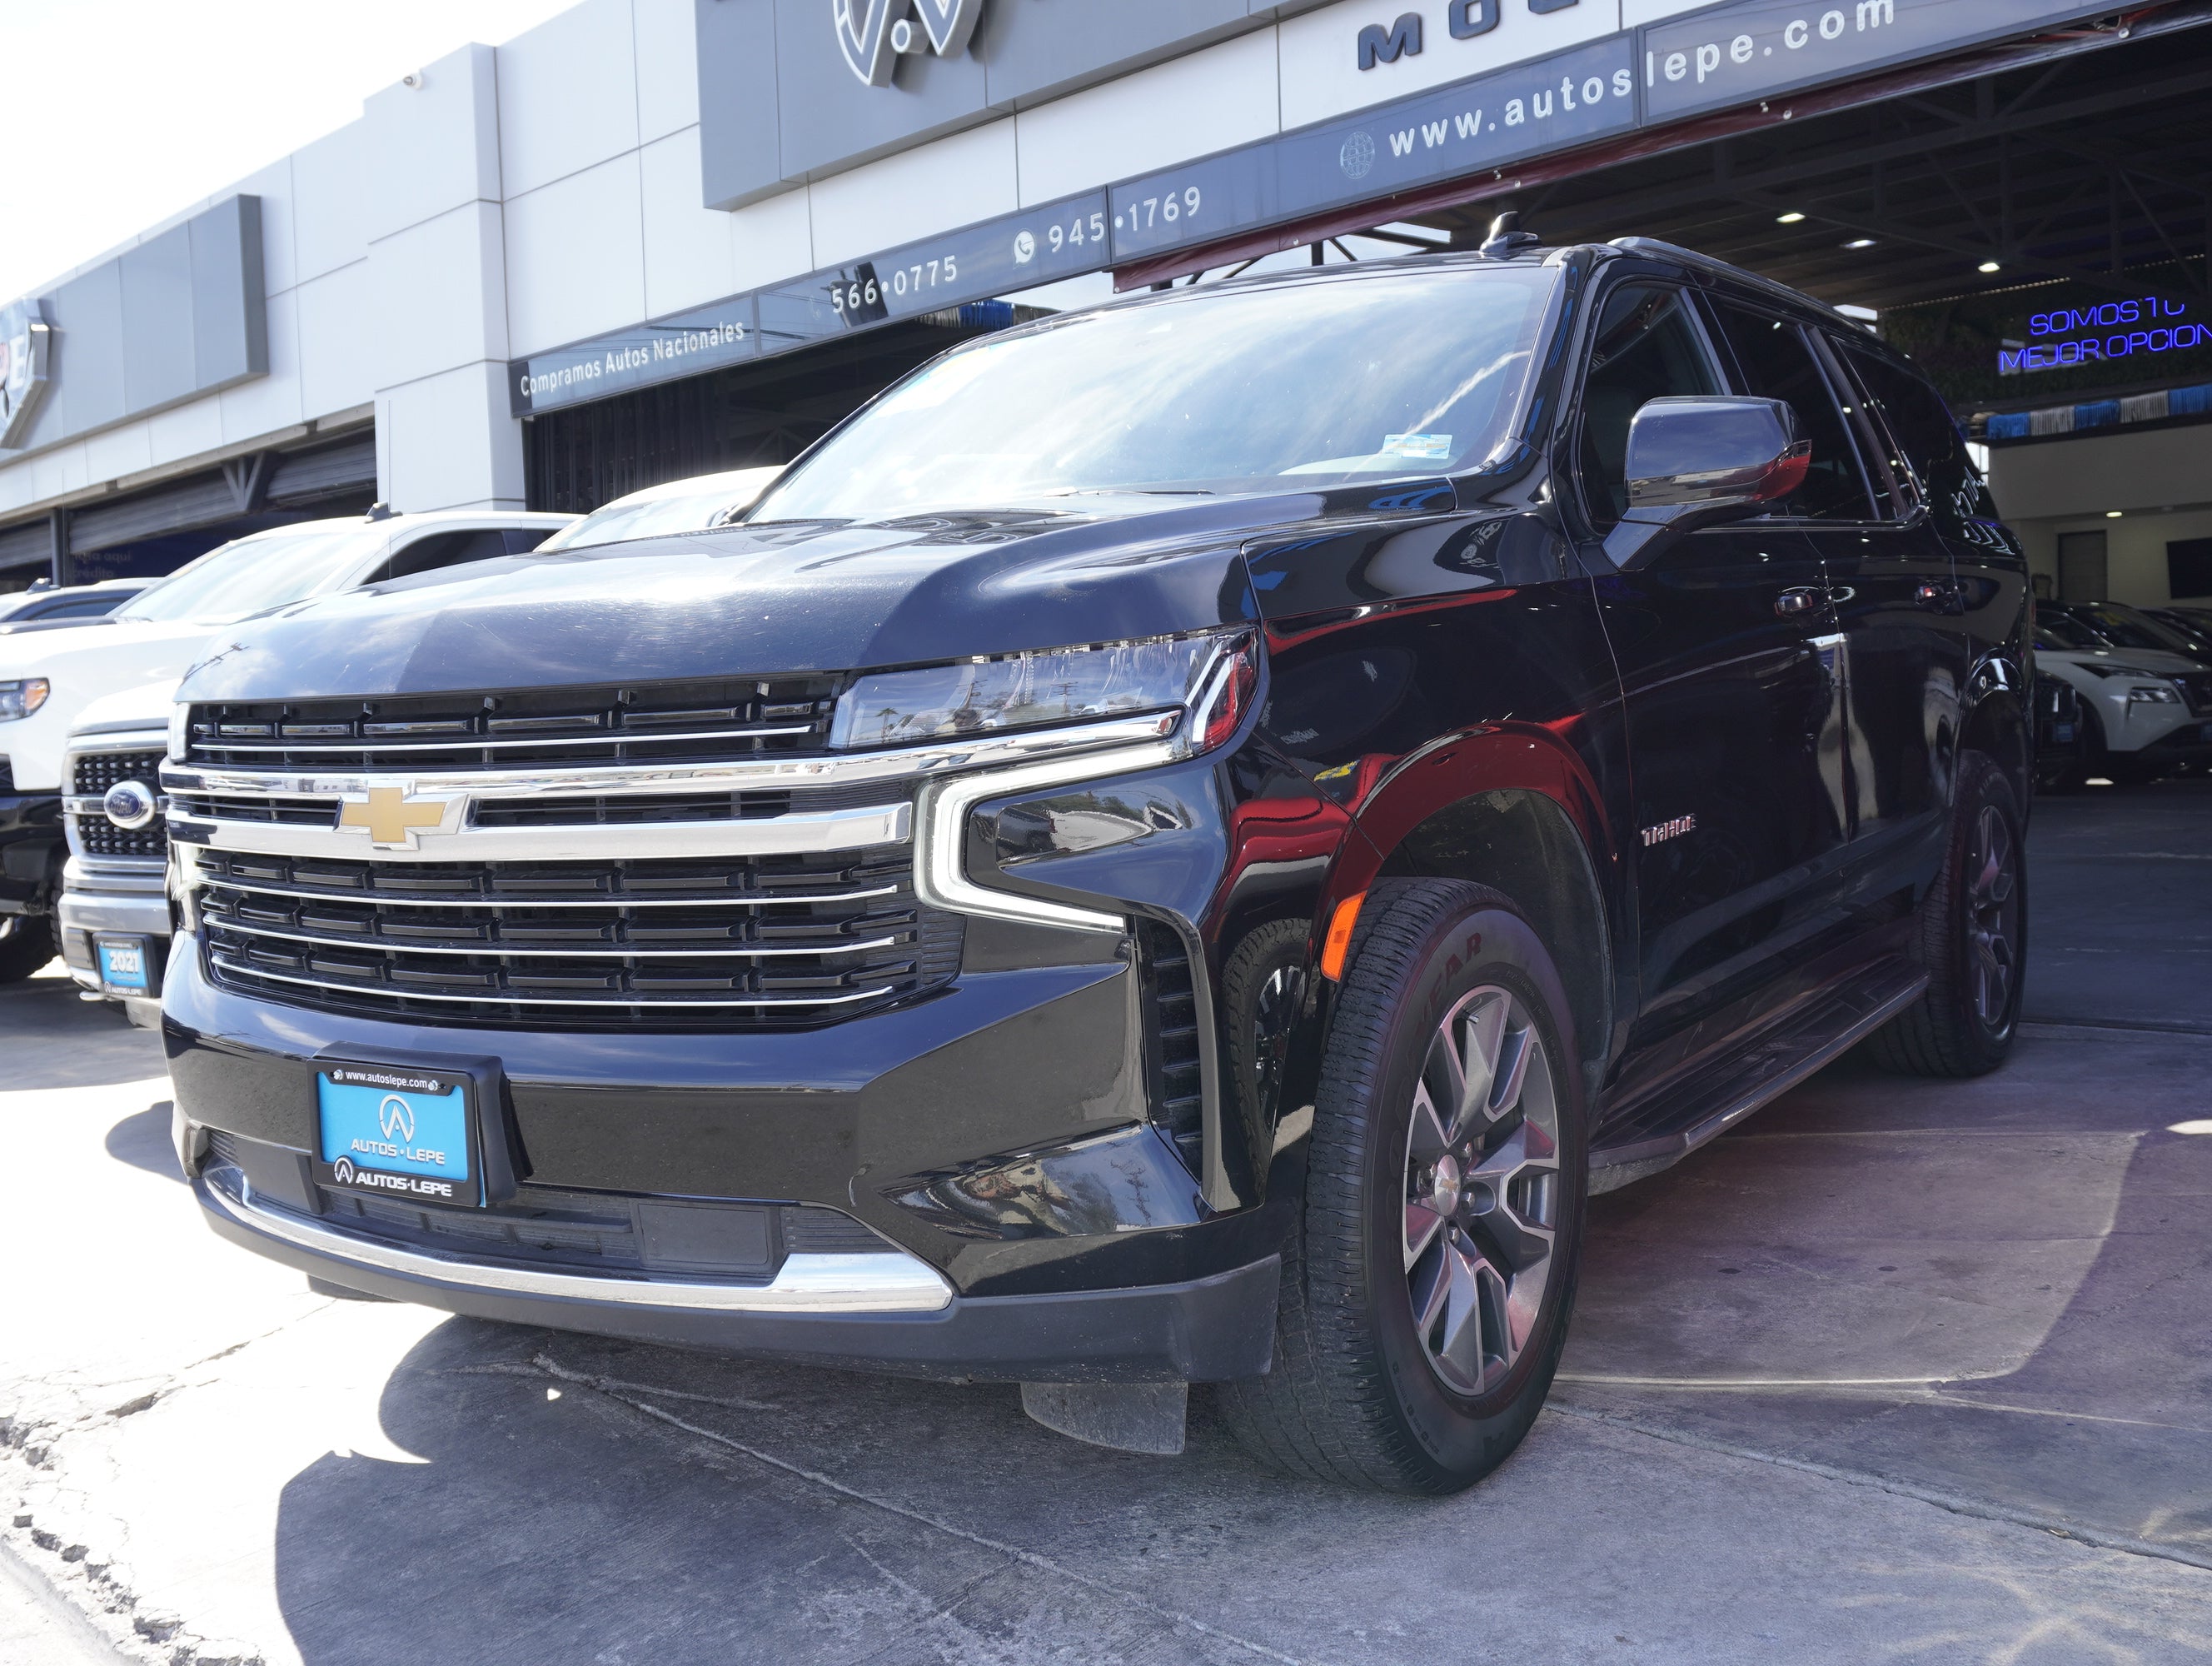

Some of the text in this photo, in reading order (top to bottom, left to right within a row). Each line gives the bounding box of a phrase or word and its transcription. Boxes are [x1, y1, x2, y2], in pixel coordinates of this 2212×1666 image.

[1358, 0, 1578, 71] MO
[2029, 300, 2140, 336] SOMOS
[520, 321, 745, 398] Compramos Autos Nacionales
[2000, 338, 2100, 372] MEJOR
[109, 950, 139, 973] 2021
[346, 1071, 428, 1089] www.autoslepe.com
